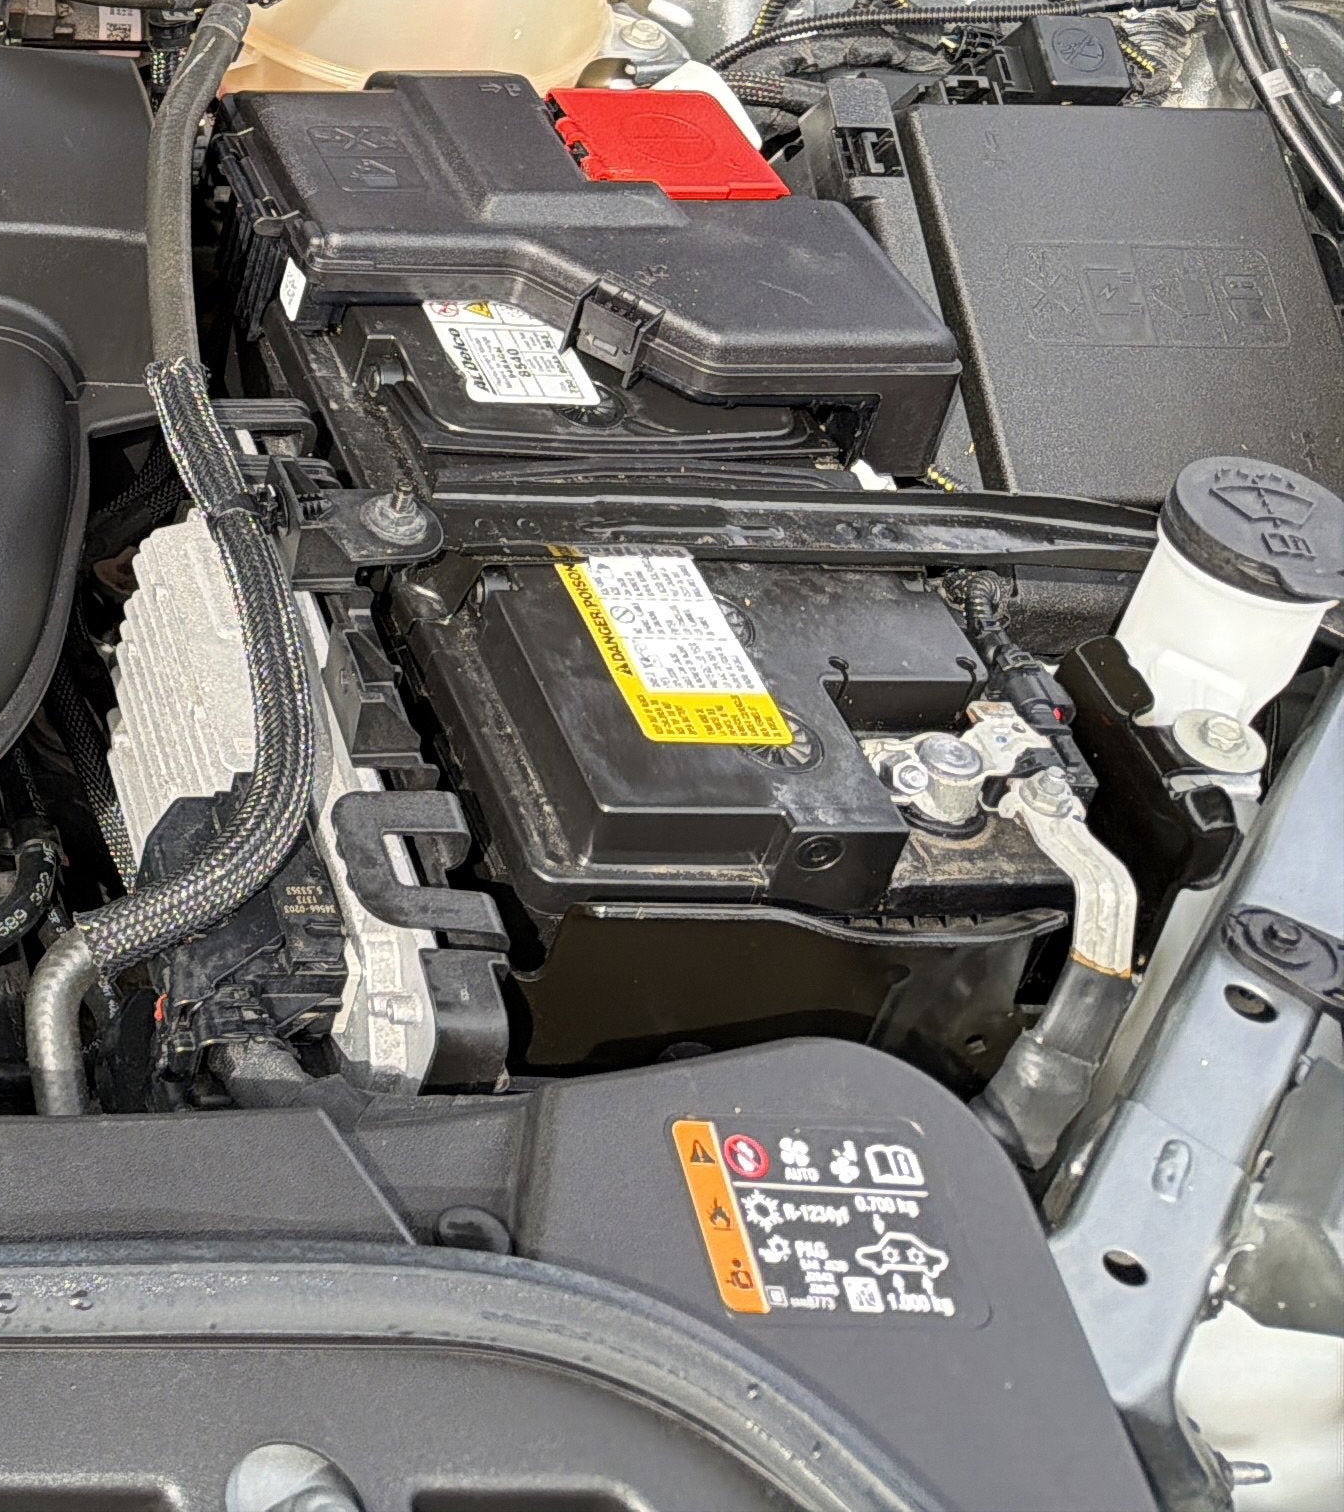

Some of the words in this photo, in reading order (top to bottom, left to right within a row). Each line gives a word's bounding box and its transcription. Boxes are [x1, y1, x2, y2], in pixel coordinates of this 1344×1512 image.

[447, 327, 490, 393] ACDelco
[784, 1166, 820, 1183] AUTO
[896, 1198, 920, 1218] kg
[930, 1295, 955, 1317] kg
